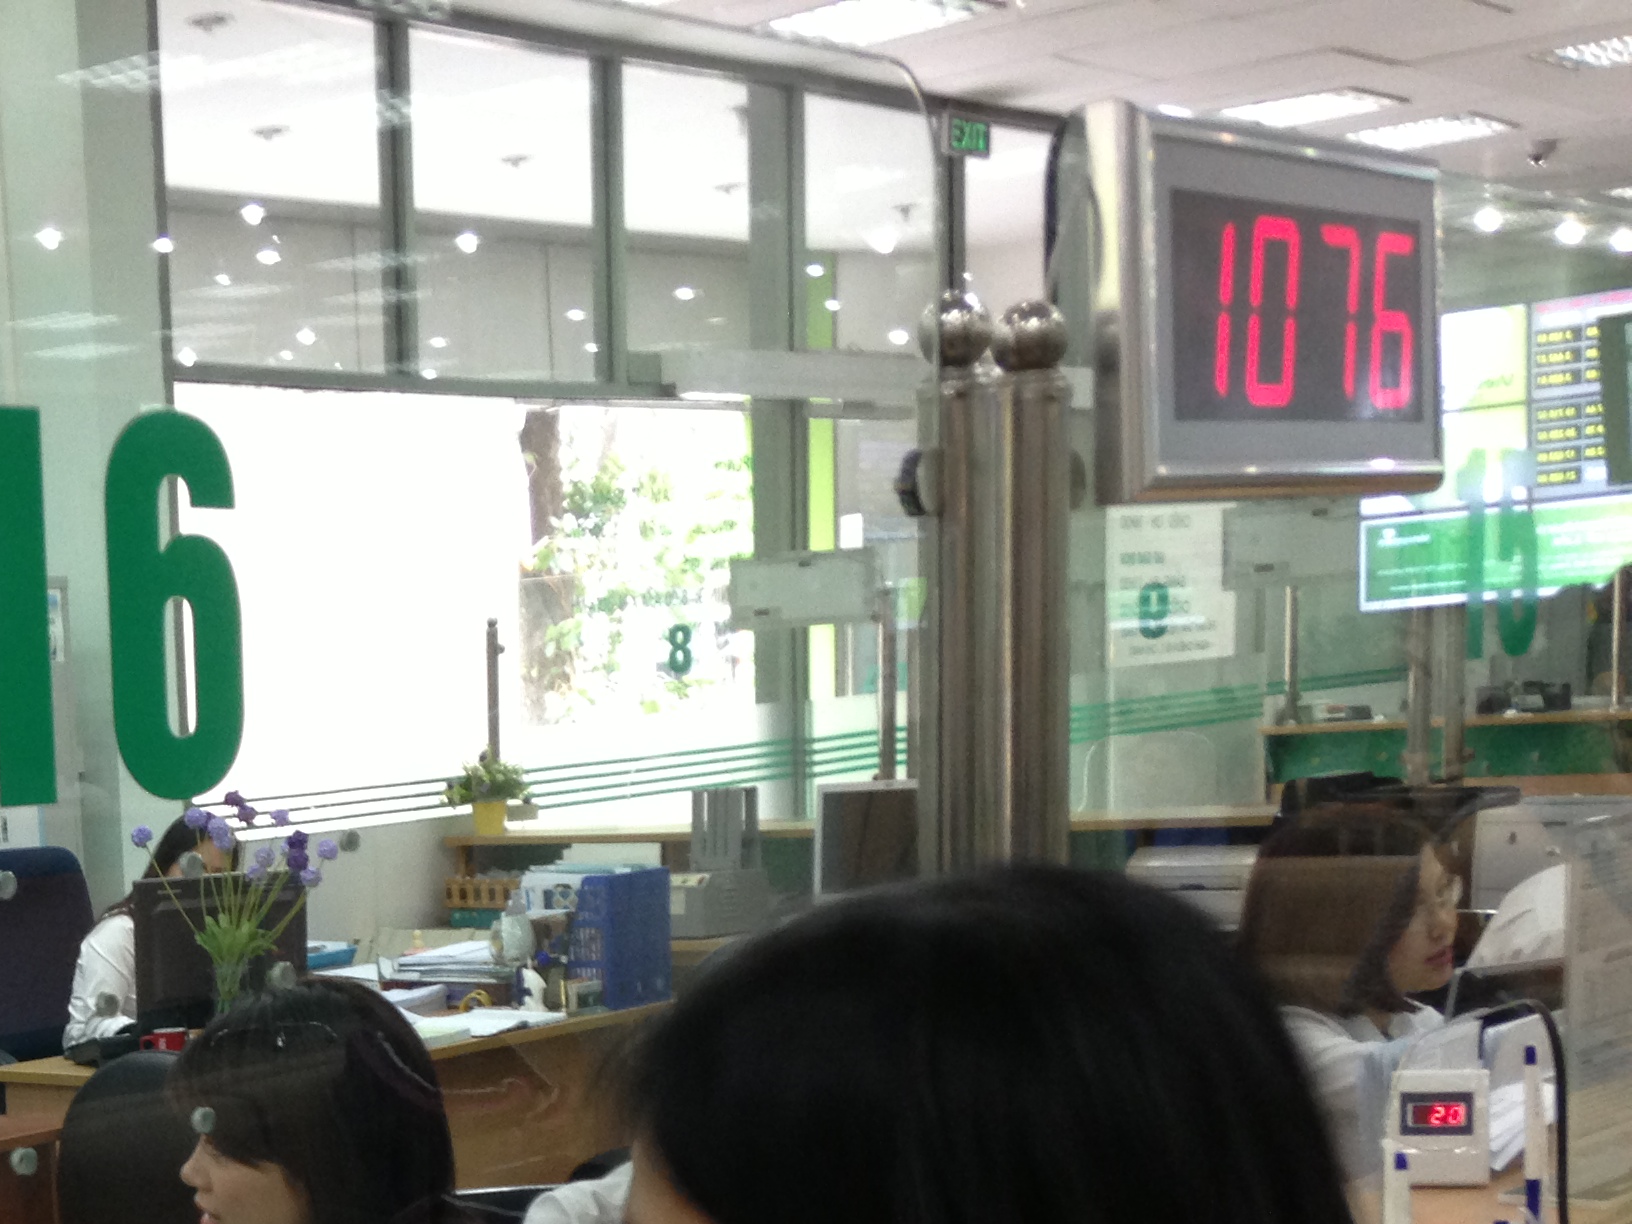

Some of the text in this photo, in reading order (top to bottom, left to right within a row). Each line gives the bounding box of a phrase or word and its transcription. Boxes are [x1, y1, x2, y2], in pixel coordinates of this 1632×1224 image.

[952, 118, 986, 151] EXIT
[1214, 213, 1415, 410] 1076
[669, 623, 692, 673] 8
[1429, 1105, 1465, 1127] 20
